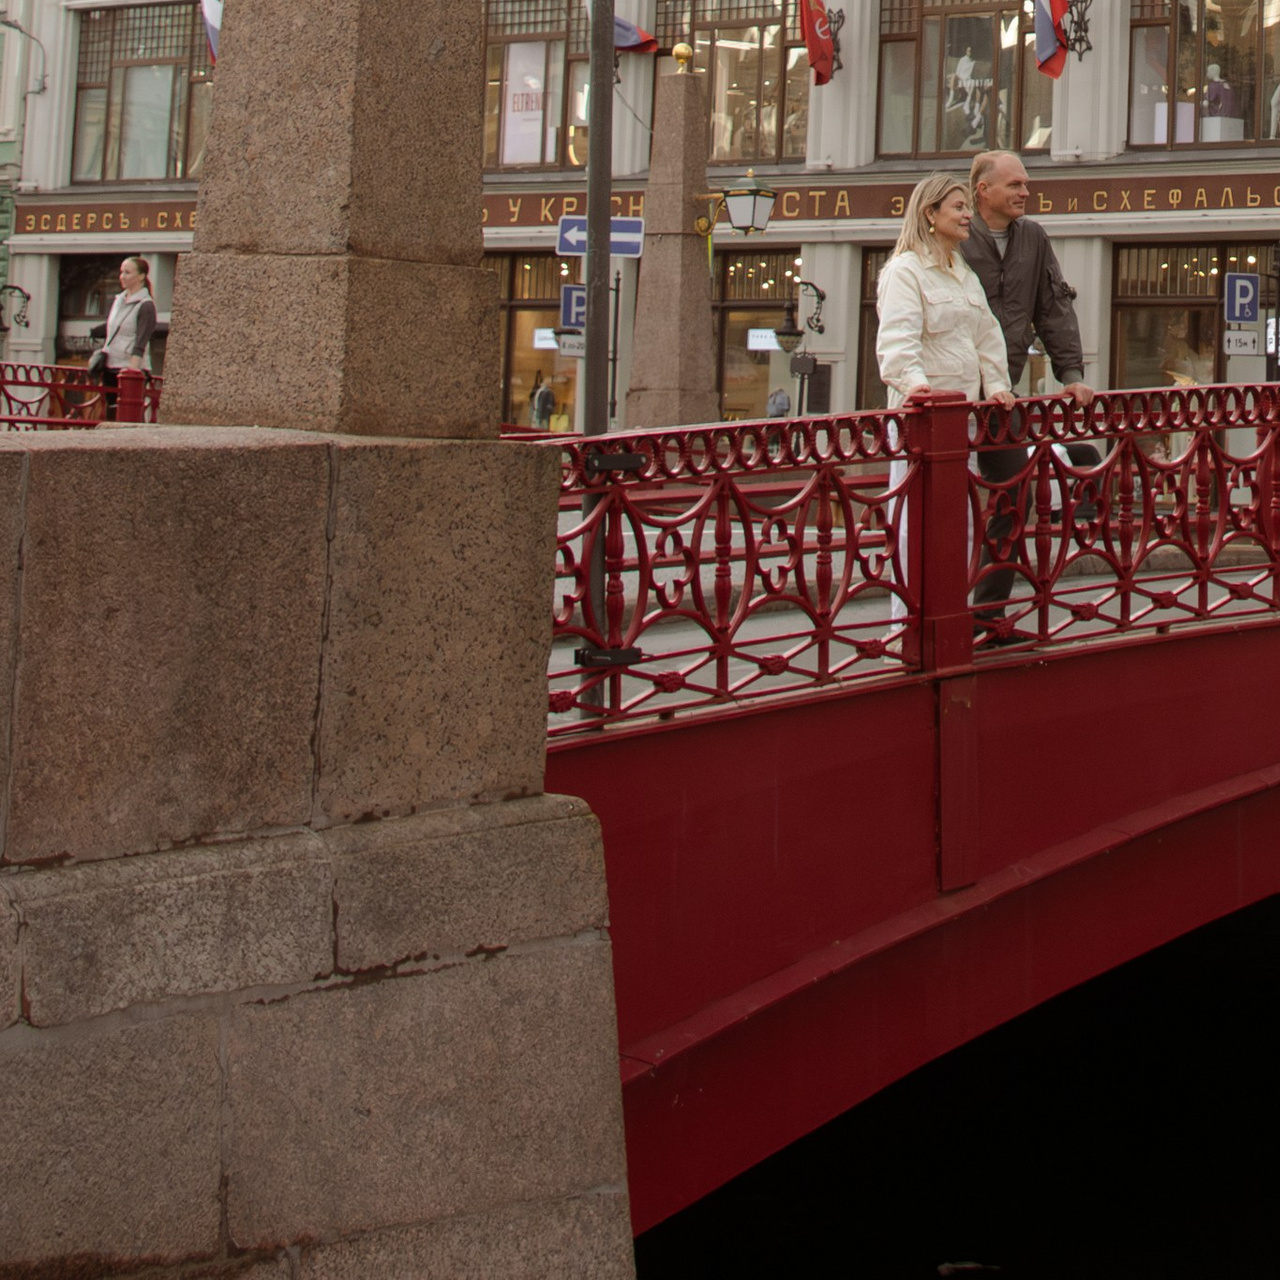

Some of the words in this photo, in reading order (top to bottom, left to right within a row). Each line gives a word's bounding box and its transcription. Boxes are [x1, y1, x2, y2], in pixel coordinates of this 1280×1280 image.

[508, 197, 522, 223] У
[770, 190, 851, 217] СТА
[25, 212, 130, 232] ЭСДЕРСЪ
[1235, 279, 1254, 318] P
